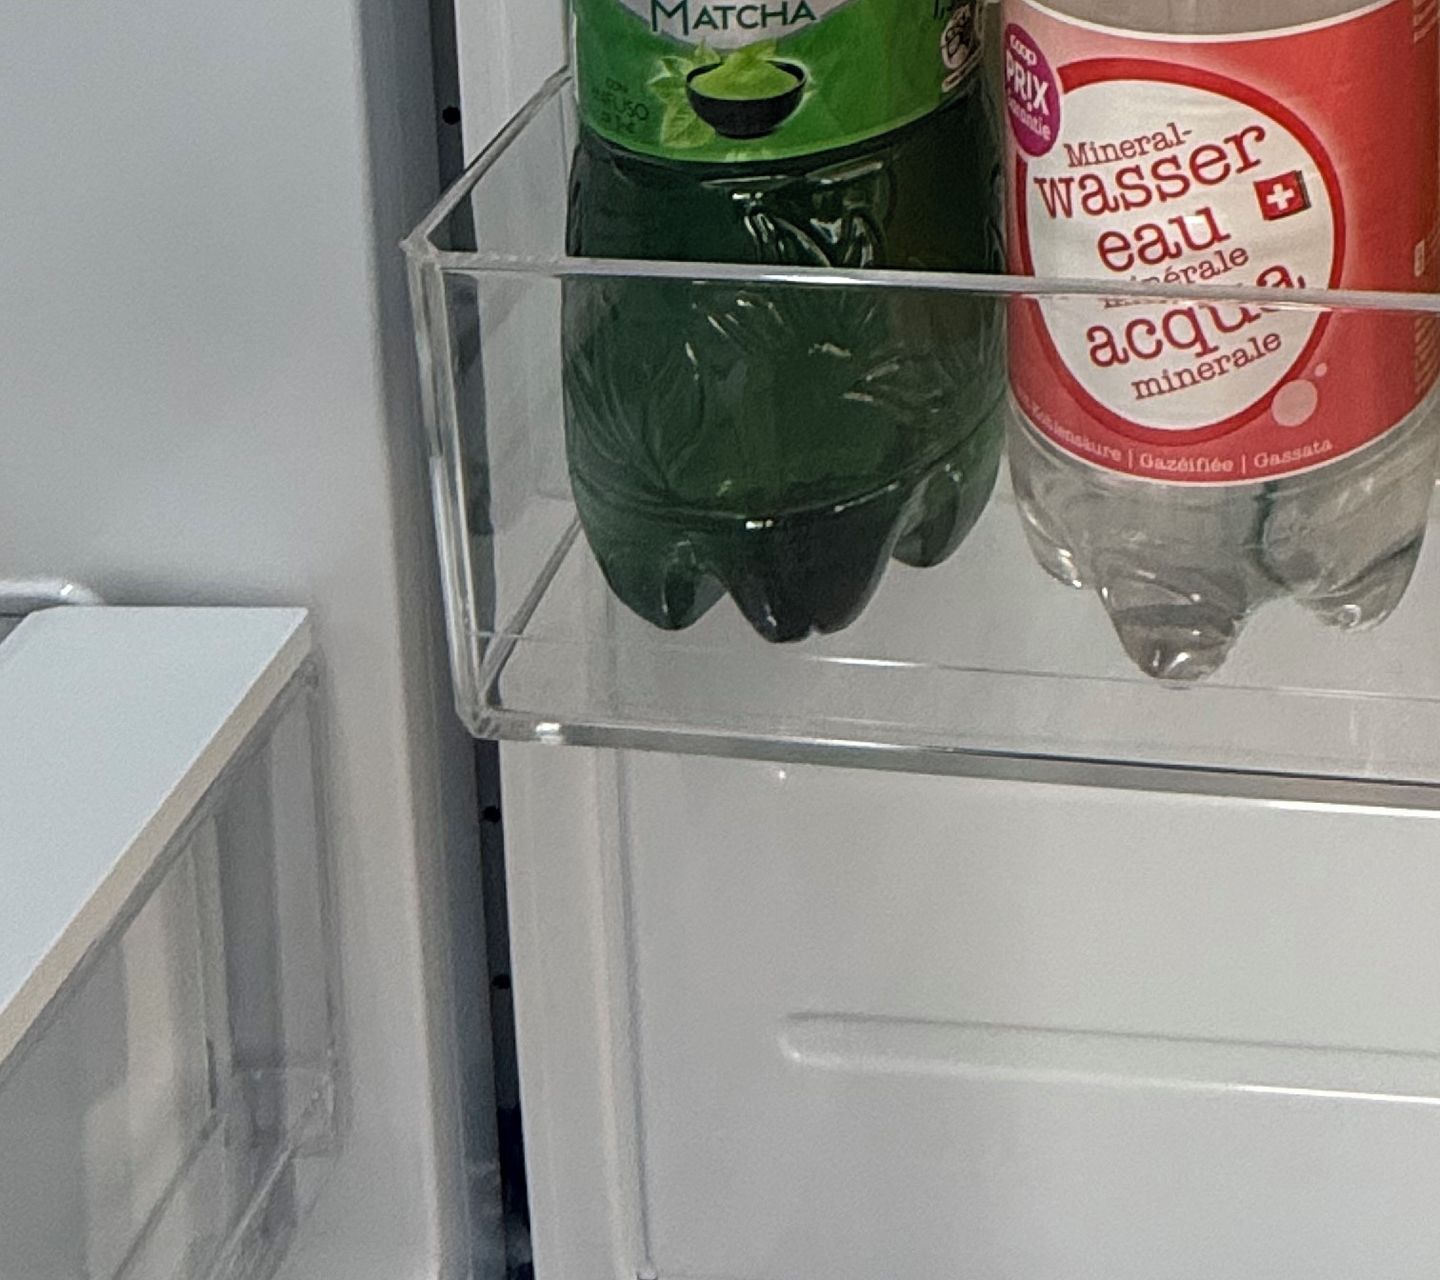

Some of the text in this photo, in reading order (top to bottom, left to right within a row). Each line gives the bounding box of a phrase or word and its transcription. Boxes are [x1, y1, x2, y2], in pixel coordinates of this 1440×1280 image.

[1033, 123, 1269, 220] wasser
[1063, 123, 1194, 170] Mineral-
[1097, 207, 1231, 274] eau
[1130, 332, 1283, 401] minerale
[1139, 453, 1235, 473] Gazéifiée
[1253, 439, 1334, 468] Gassata
